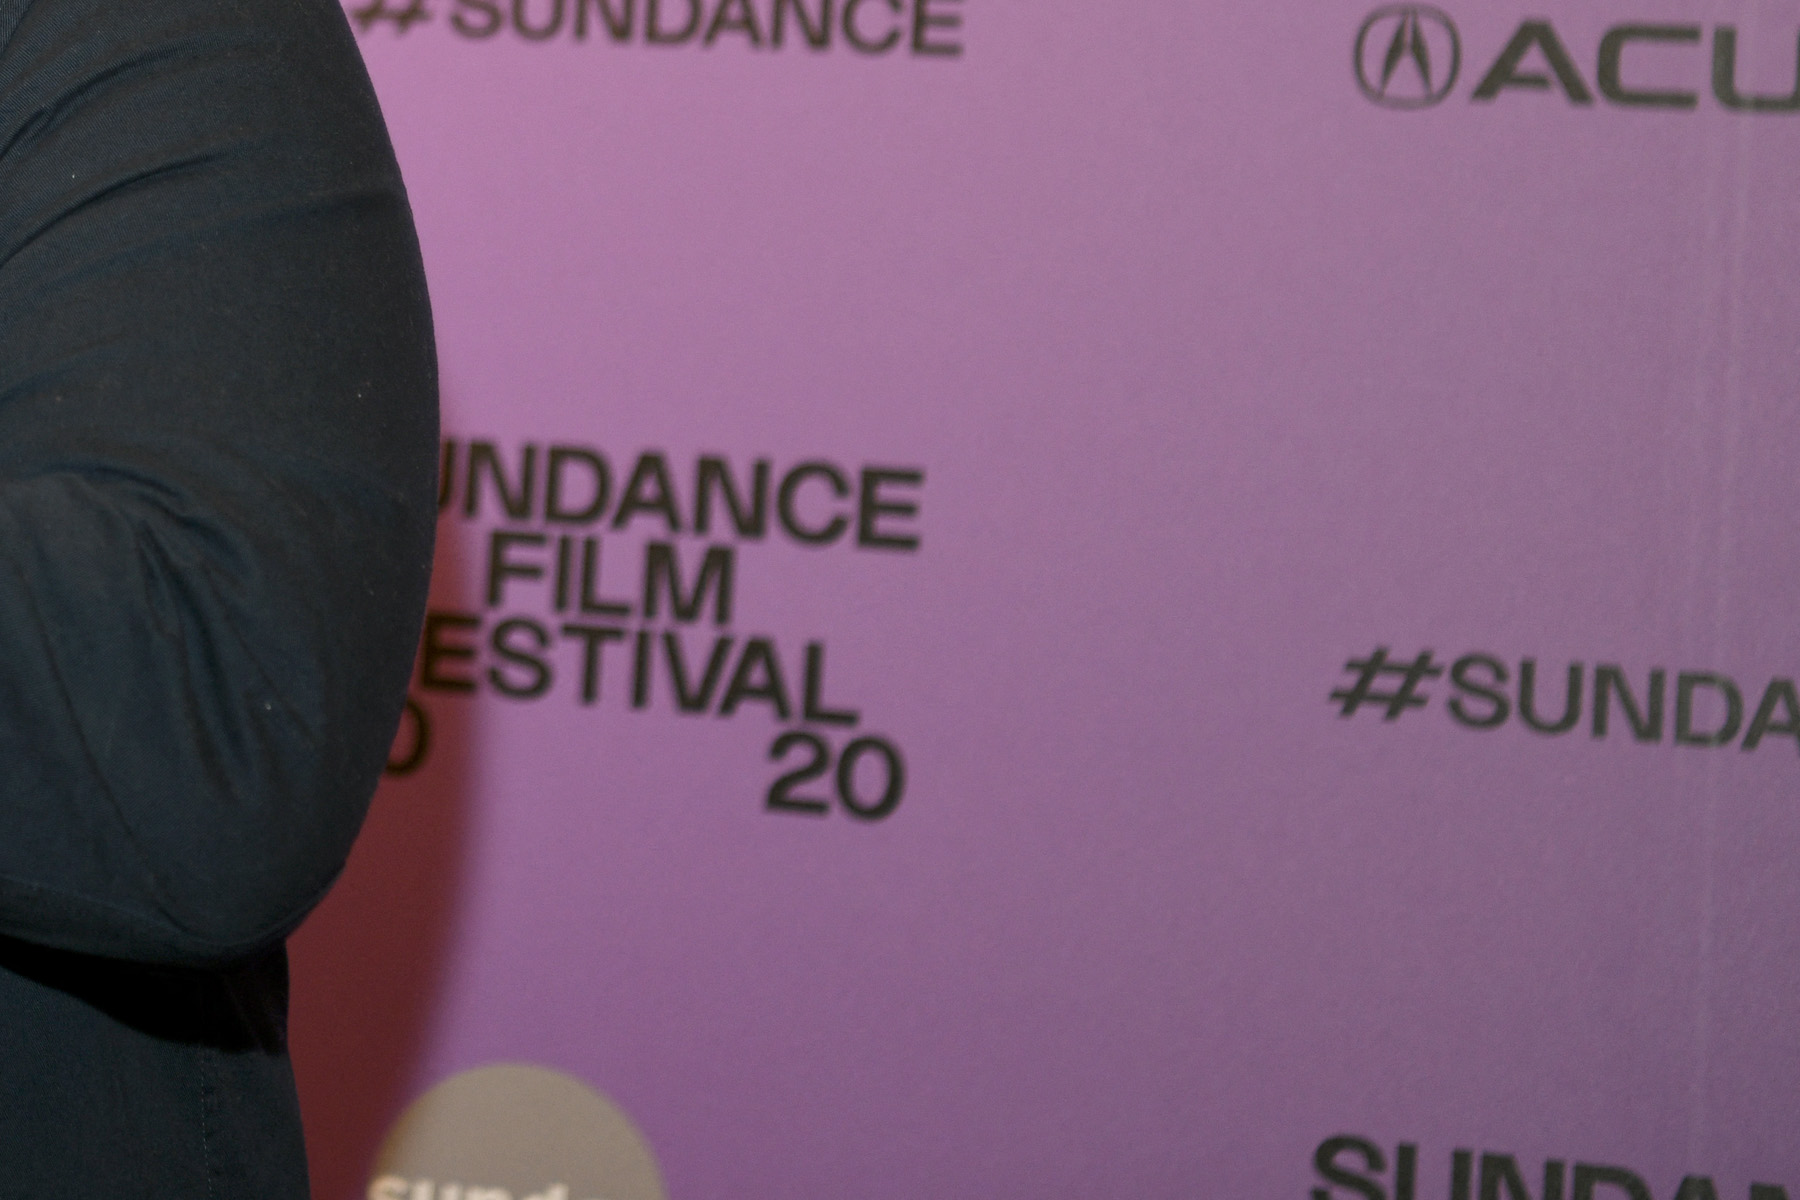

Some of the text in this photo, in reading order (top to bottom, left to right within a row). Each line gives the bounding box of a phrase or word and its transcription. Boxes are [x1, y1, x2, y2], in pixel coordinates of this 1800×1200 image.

[1472, 18, 1800, 112] ACU
[487, 530, 736, 625] FILM
[420, 612, 860, 727] ESTIVAL
[1330, 648, 1800, 753] #SUNDA
[764, 732, 906, 822] 20
